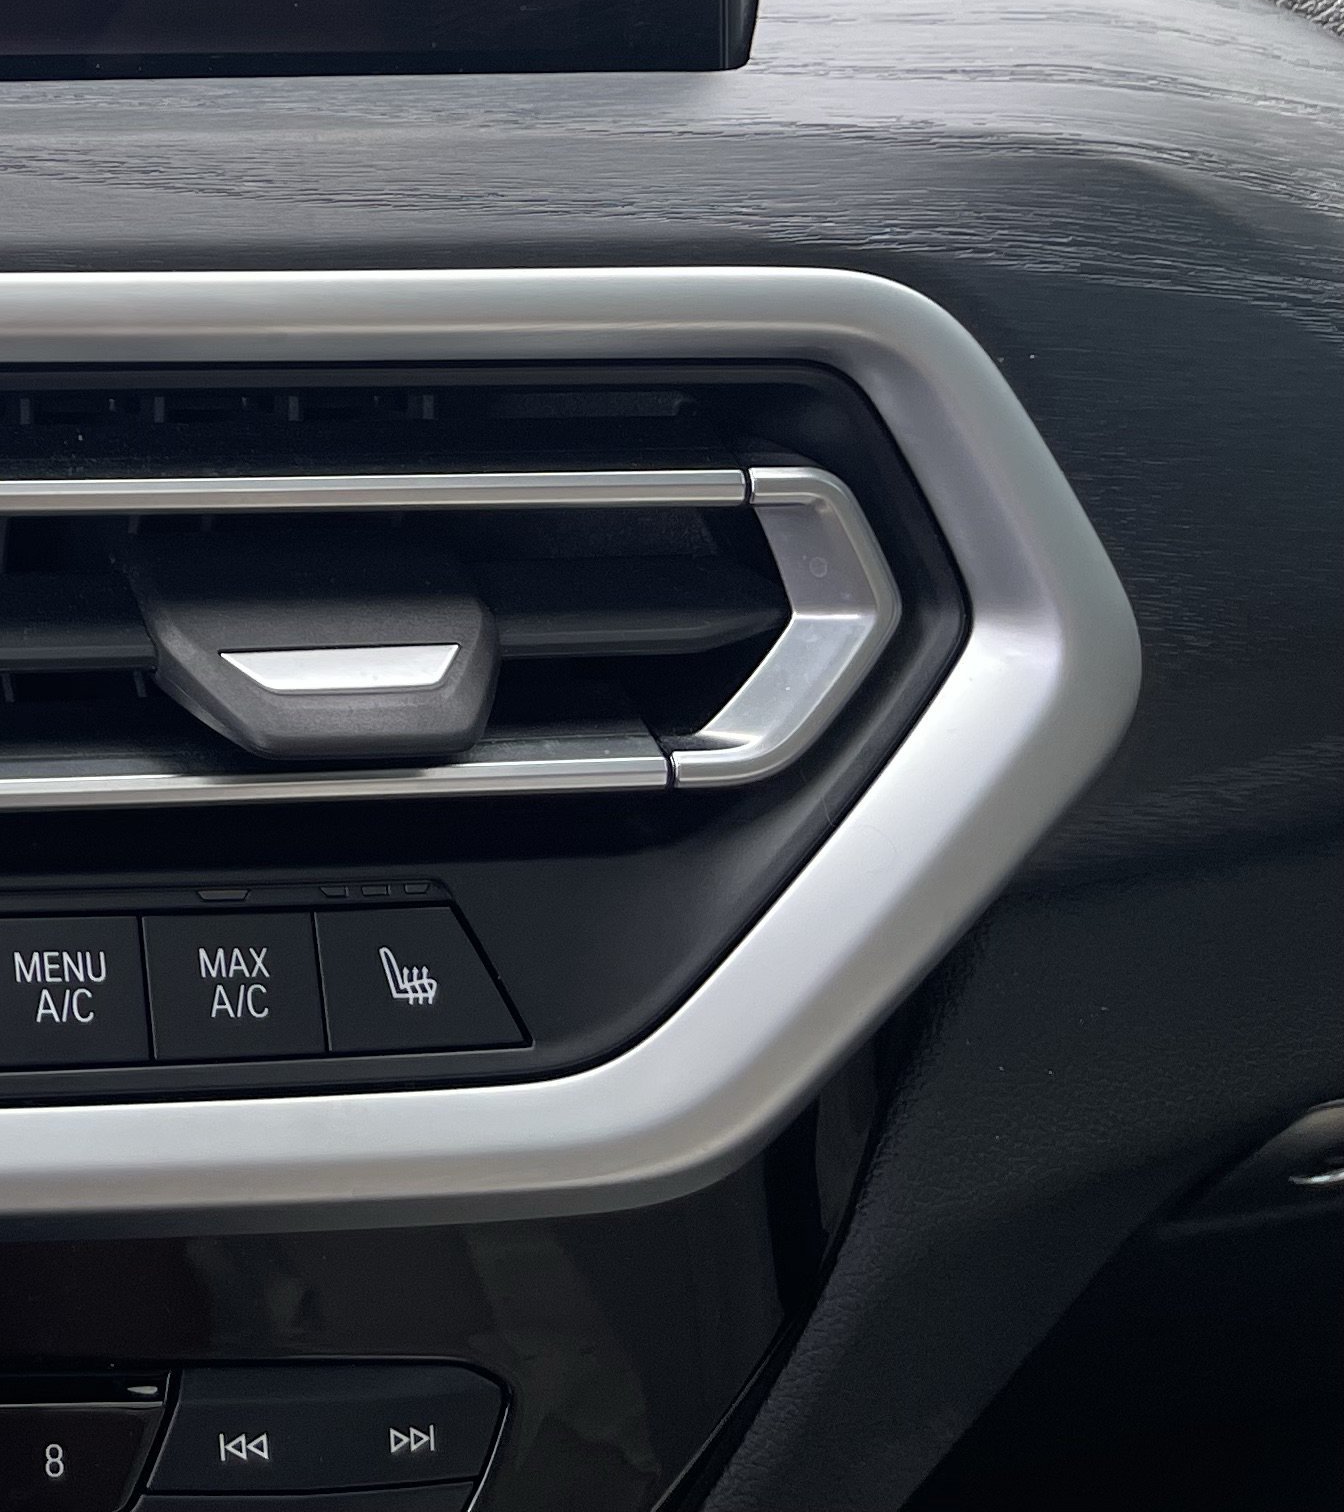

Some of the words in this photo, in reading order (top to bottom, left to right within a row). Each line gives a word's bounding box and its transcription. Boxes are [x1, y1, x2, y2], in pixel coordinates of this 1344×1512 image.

[12, 950, 107, 984] MENU
[198, 947, 270, 978] MAX
[36, 988, 94, 1023] A/C
[211, 984, 269, 1018] A/C
[45, 1443, 65, 1478] 8
